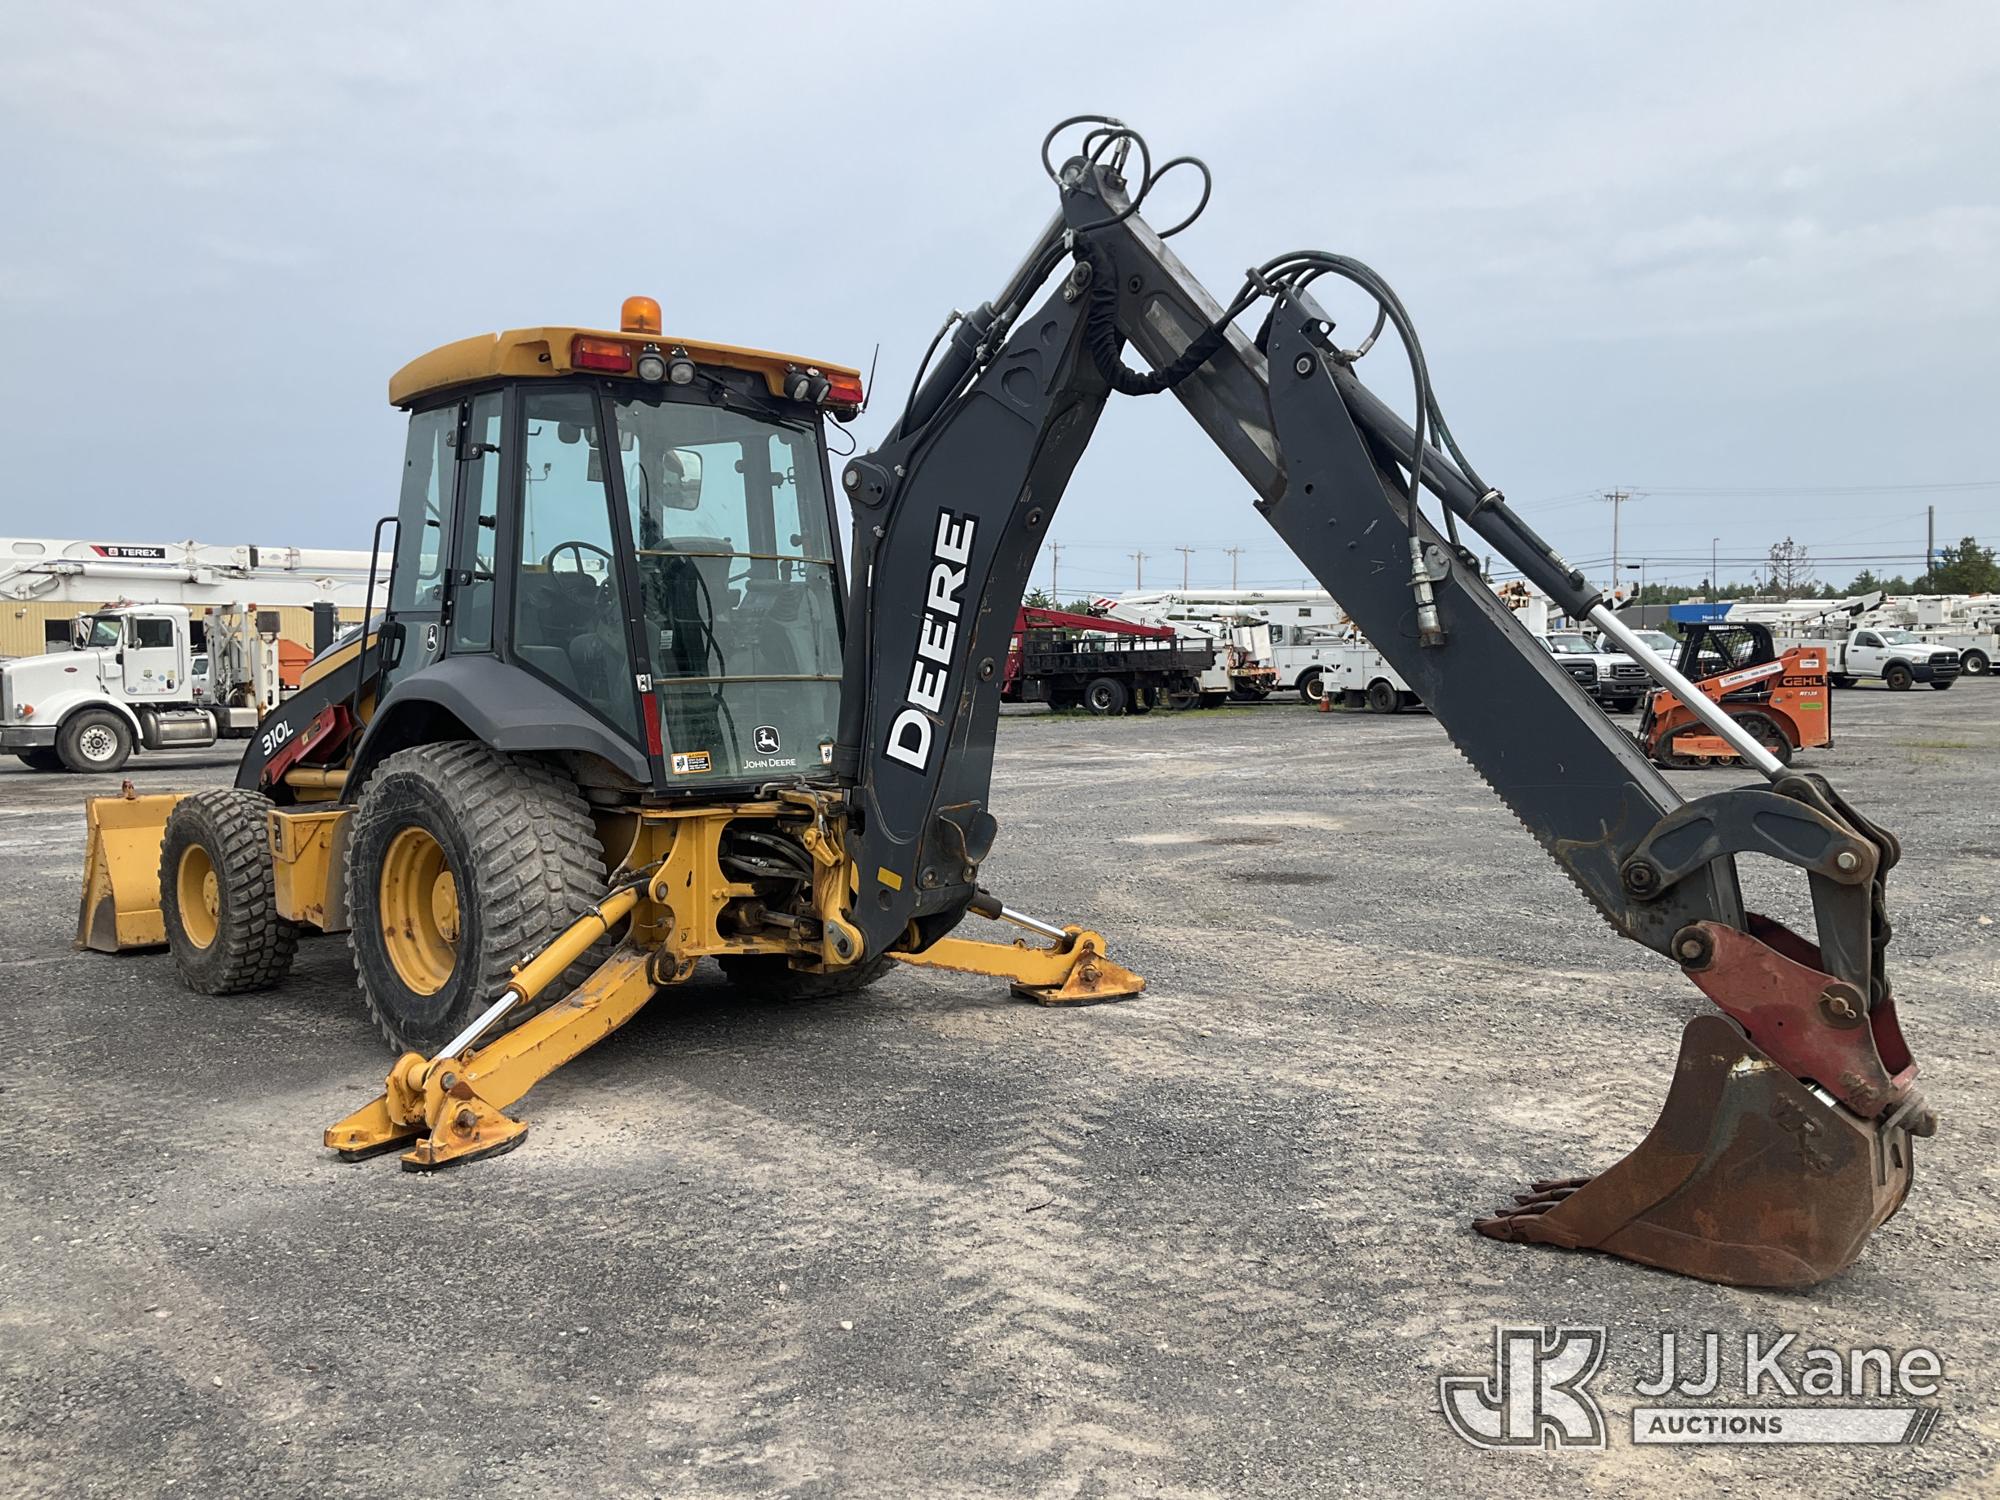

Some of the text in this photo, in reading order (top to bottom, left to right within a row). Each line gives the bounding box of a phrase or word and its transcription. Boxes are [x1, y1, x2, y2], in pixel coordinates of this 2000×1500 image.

[121, 548, 157, 557] TEREX
[886, 513, 975, 770] DEERE
[1783, 677, 1822, 686] GEHL
[262, 720, 294, 756] 310L
[743, 758, 797, 769] JOHN DEERE
